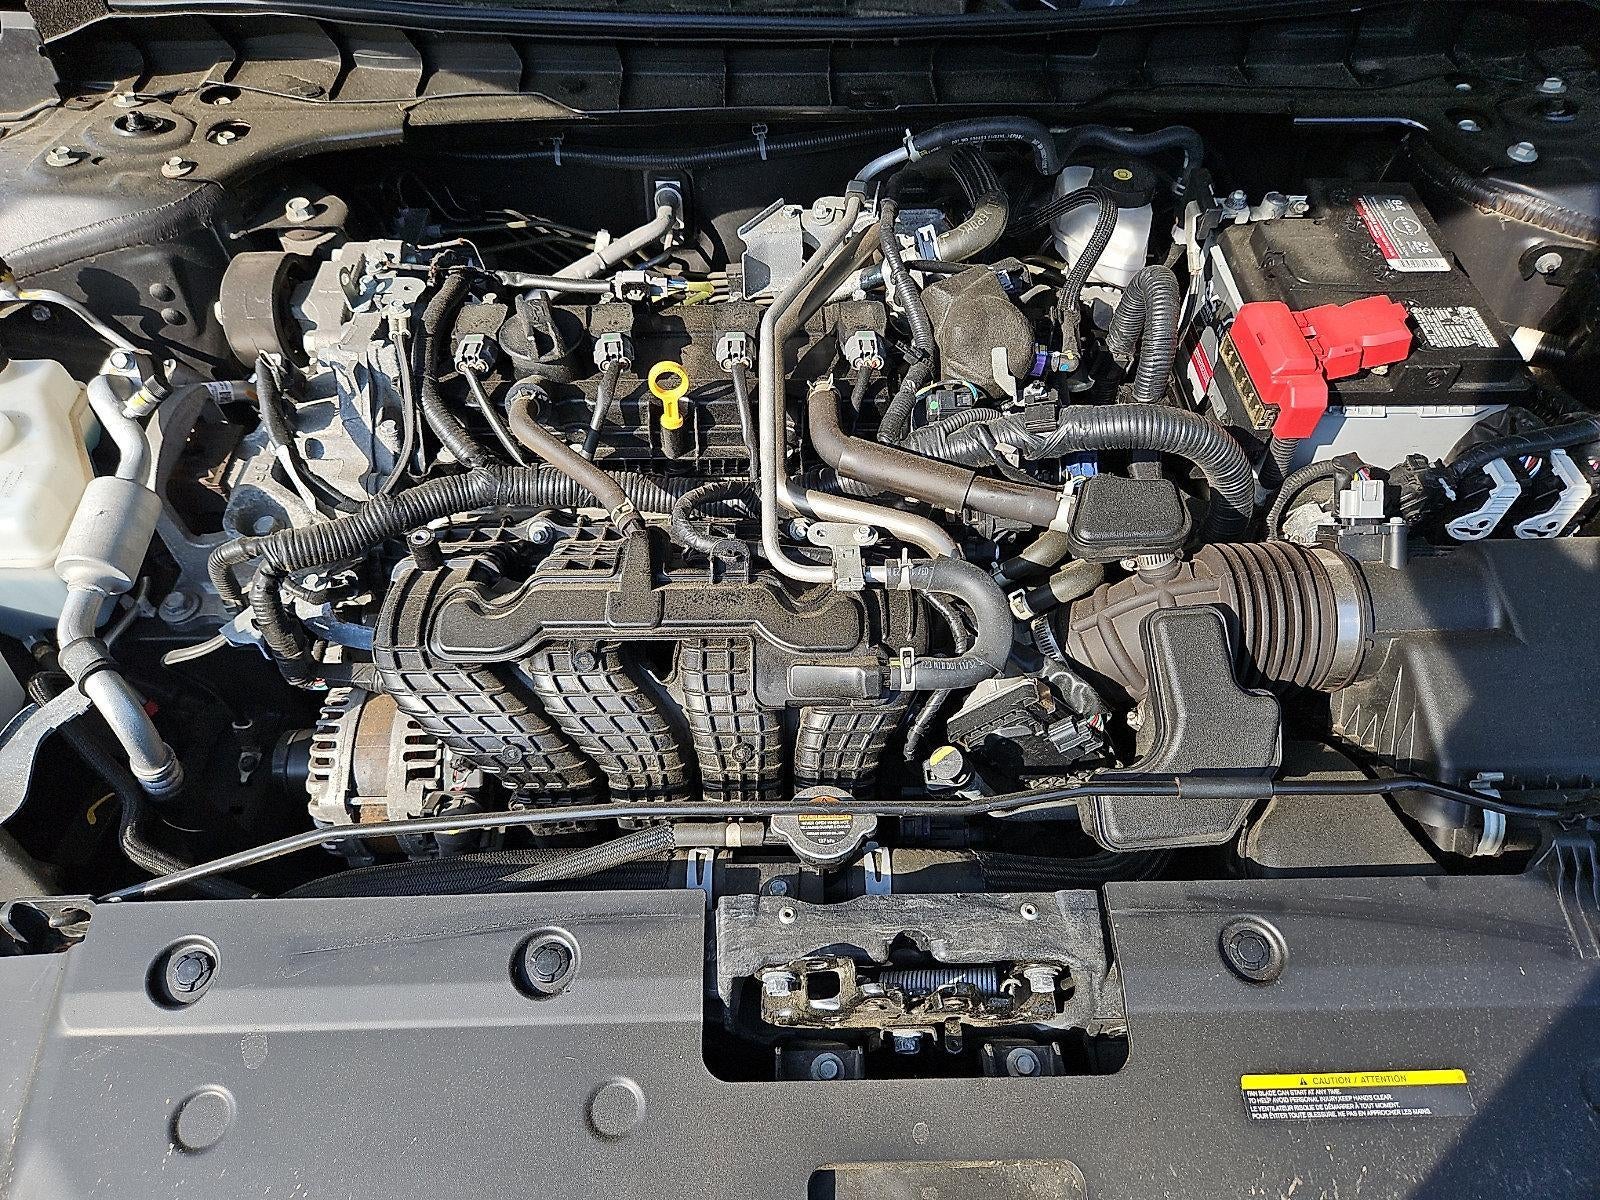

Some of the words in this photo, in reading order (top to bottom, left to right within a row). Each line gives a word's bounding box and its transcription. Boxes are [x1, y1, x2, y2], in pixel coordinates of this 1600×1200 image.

[1313, 1077, 1351, 1085] CAUTION
[1361, 1075, 1407, 1083] ATTENTION
[1258, 1104, 1294, 1112] VENTILATEUR
